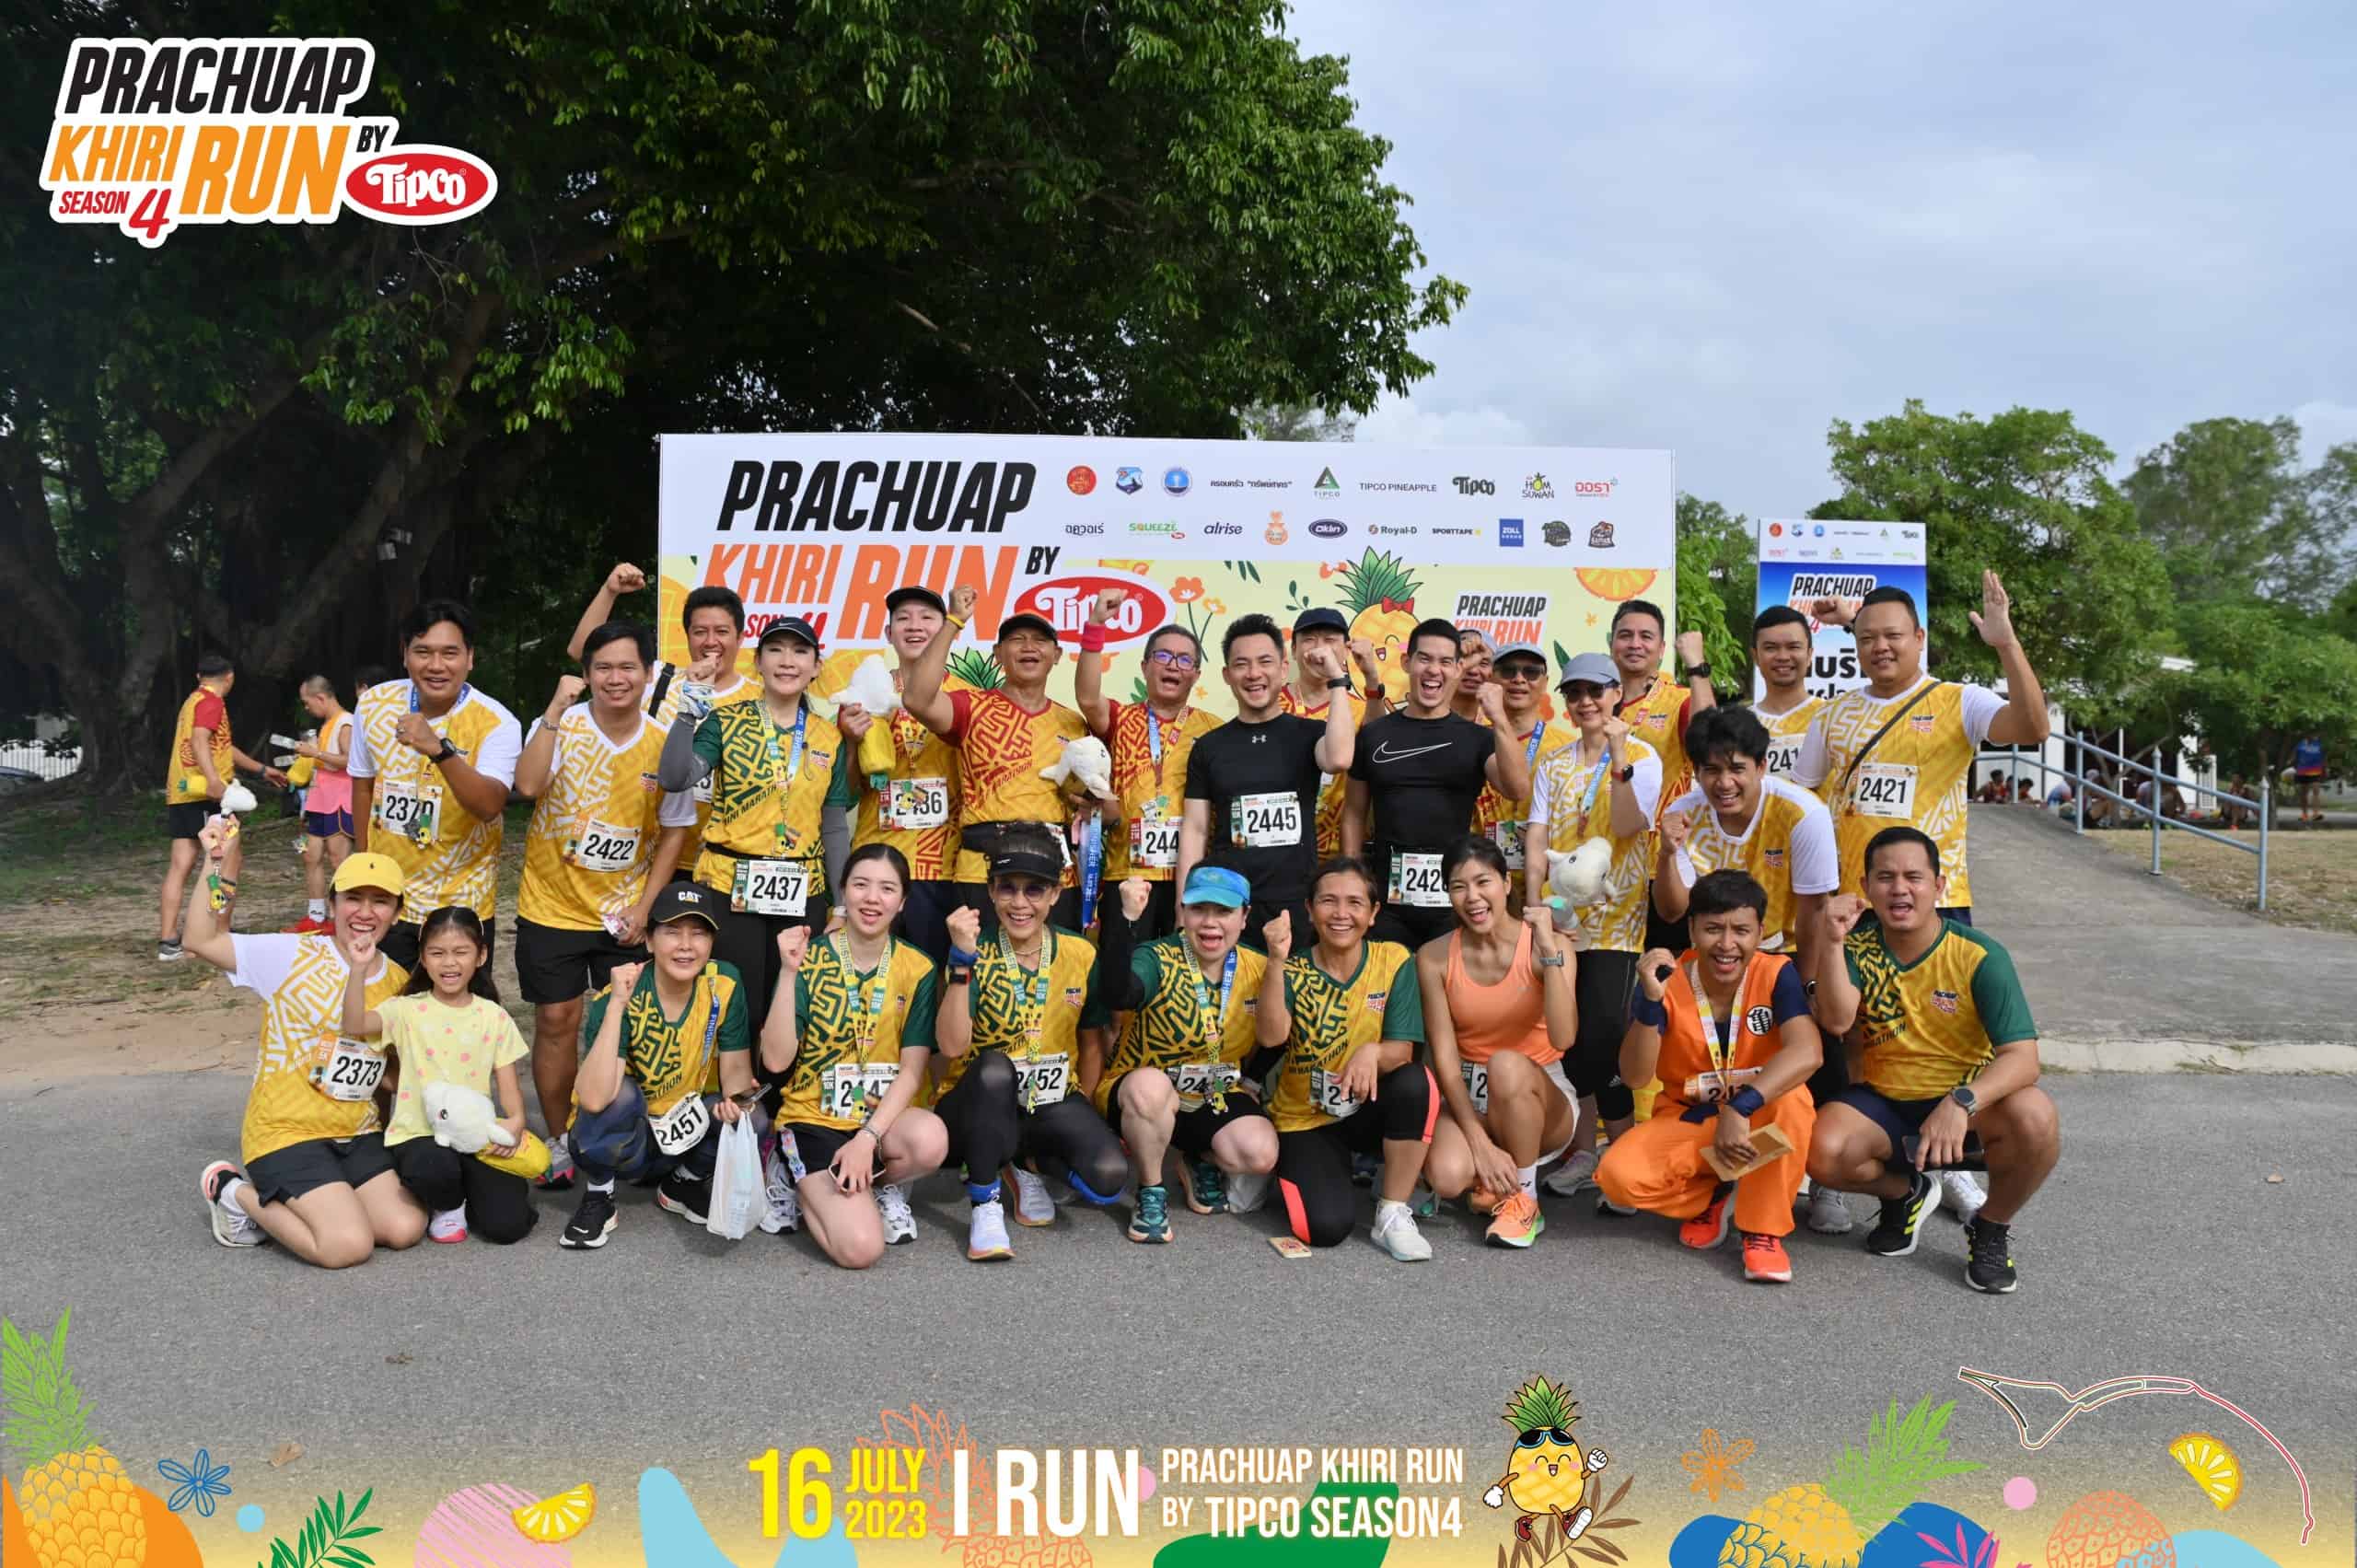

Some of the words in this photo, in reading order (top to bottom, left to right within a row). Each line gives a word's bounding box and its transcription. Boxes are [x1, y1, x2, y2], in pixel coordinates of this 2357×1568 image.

[717, 460, 1037, 532] PRACHUAP
[1360, 482, 1387, 491] TIPCO
[1388, 483, 1437, 493] PINEAPPLE
[1452, 476, 1495, 495] Tipco
[1380, 526, 1418, 536] Royal-D
[703, 543, 843, 604] KHIRI
[1024, 546, 1060, 575] BY
[1792, 576, 1874, 597] PRACHUAP
[1457, 595, 1547, 617] PRACHUAP
[1494, 620, 1543, 645] RUN
[1860, 777, 1907, 804] 2421
[896, 791, 943, 816] 236
[1247, 807, 1296, 833] 2445
[584, 834, 634, 861] 2422
[1145, 830, 1179, 854] 244
[751, 874, 802, 901] 2437
[1406, 867, 1447, 892] 242
[678, 890, 701, 903] CAT
[331, 1055, 382, 1086] 2373
[655, 1105, 703, 1145] 2451
